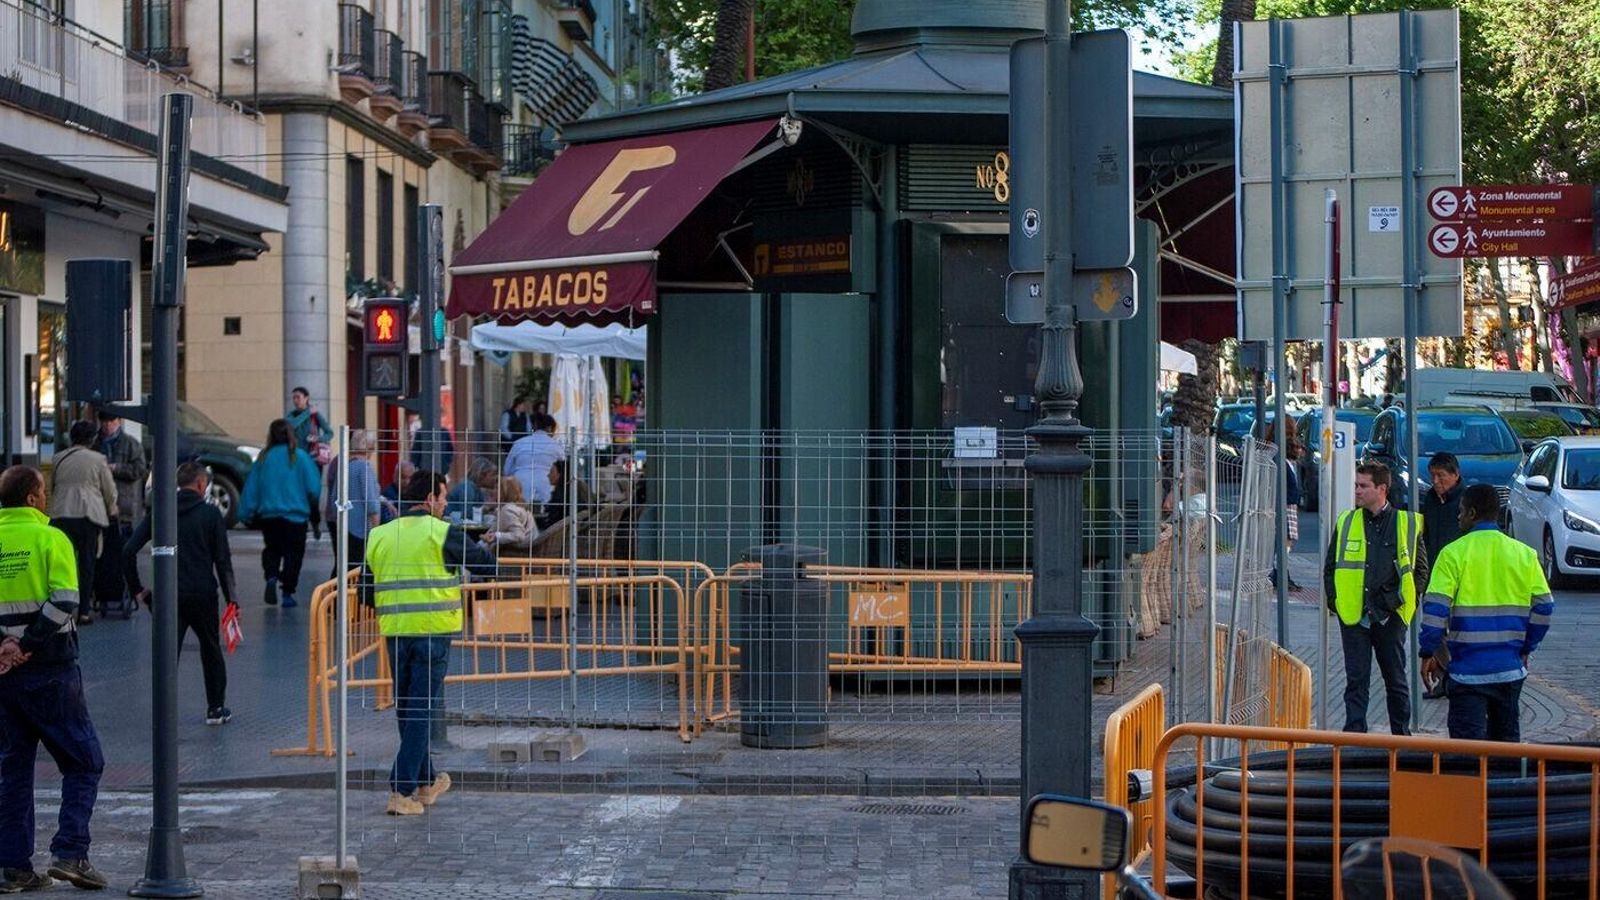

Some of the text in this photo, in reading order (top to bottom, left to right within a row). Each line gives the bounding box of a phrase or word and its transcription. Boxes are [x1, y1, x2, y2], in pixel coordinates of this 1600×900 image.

[1479, 191, 1562, 200] Zona Monumental
[1480, 206, 1556, 215] Monumental area
[1481, 228, 1546, 239] Ayuntamiento
[778, 241, 846, 259] ESTANCO
[1481, 242, 1519, 253] City Hall
[492, 270, 608, 310] TABACOS
[853, 594, 904, 622] MC
